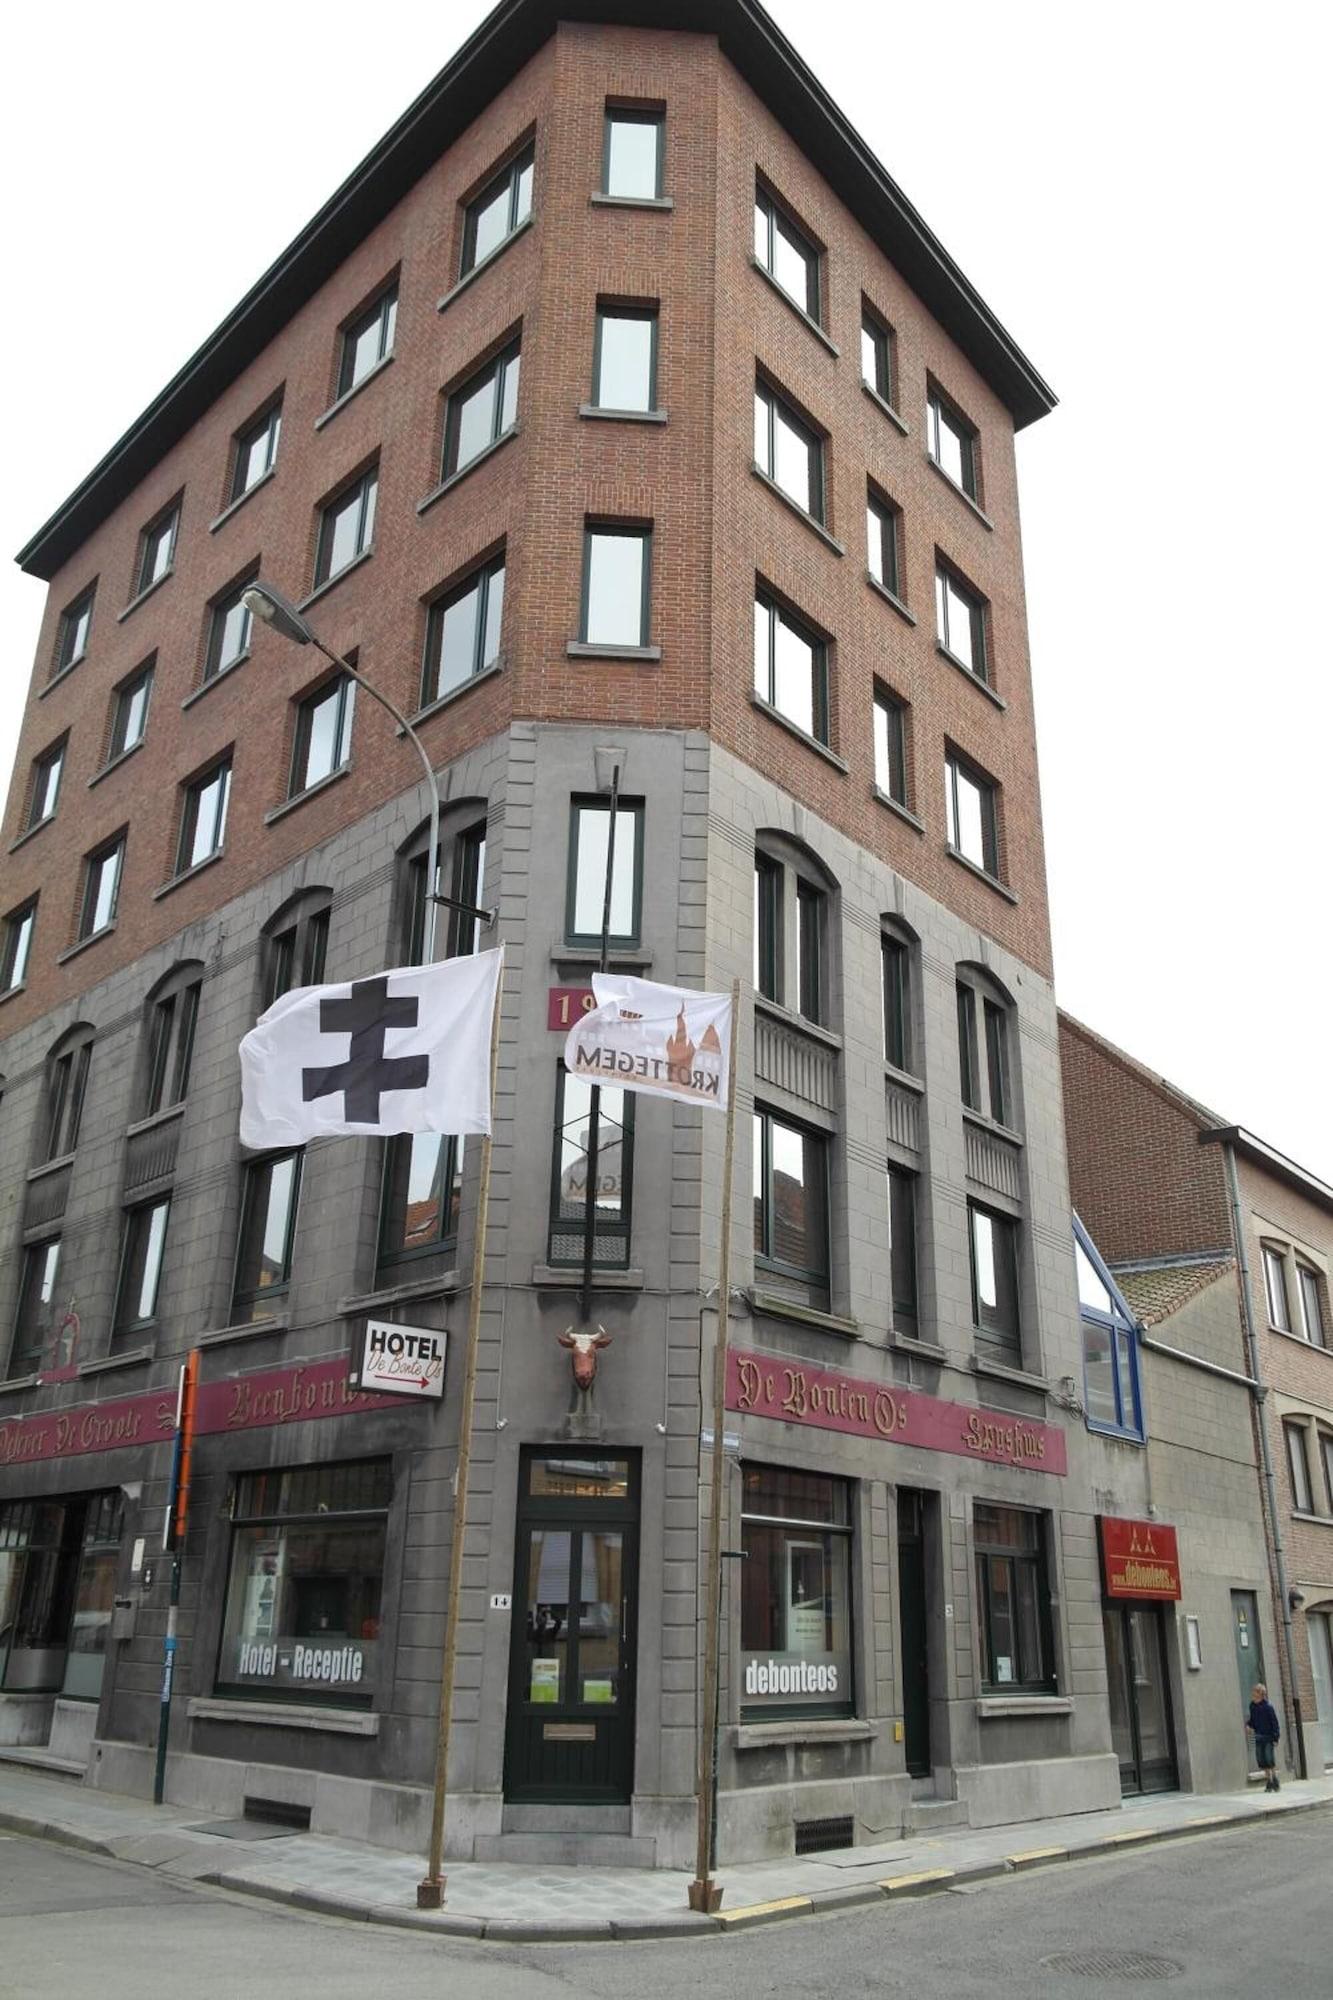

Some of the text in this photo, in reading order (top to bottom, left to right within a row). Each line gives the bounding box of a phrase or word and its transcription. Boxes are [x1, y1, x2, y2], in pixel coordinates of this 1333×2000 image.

[370, 1329, 442, 1362] HOTEL
[366, 1350, 442, 1379] De Bonte Os
[736, 1357, 908, 1435] De Bonten Os
[240, 1643, 277, 1675] Hotel
[293, 1645, 362, 1683] Receptie
[745, 1659, 838, 1694] debonteos
